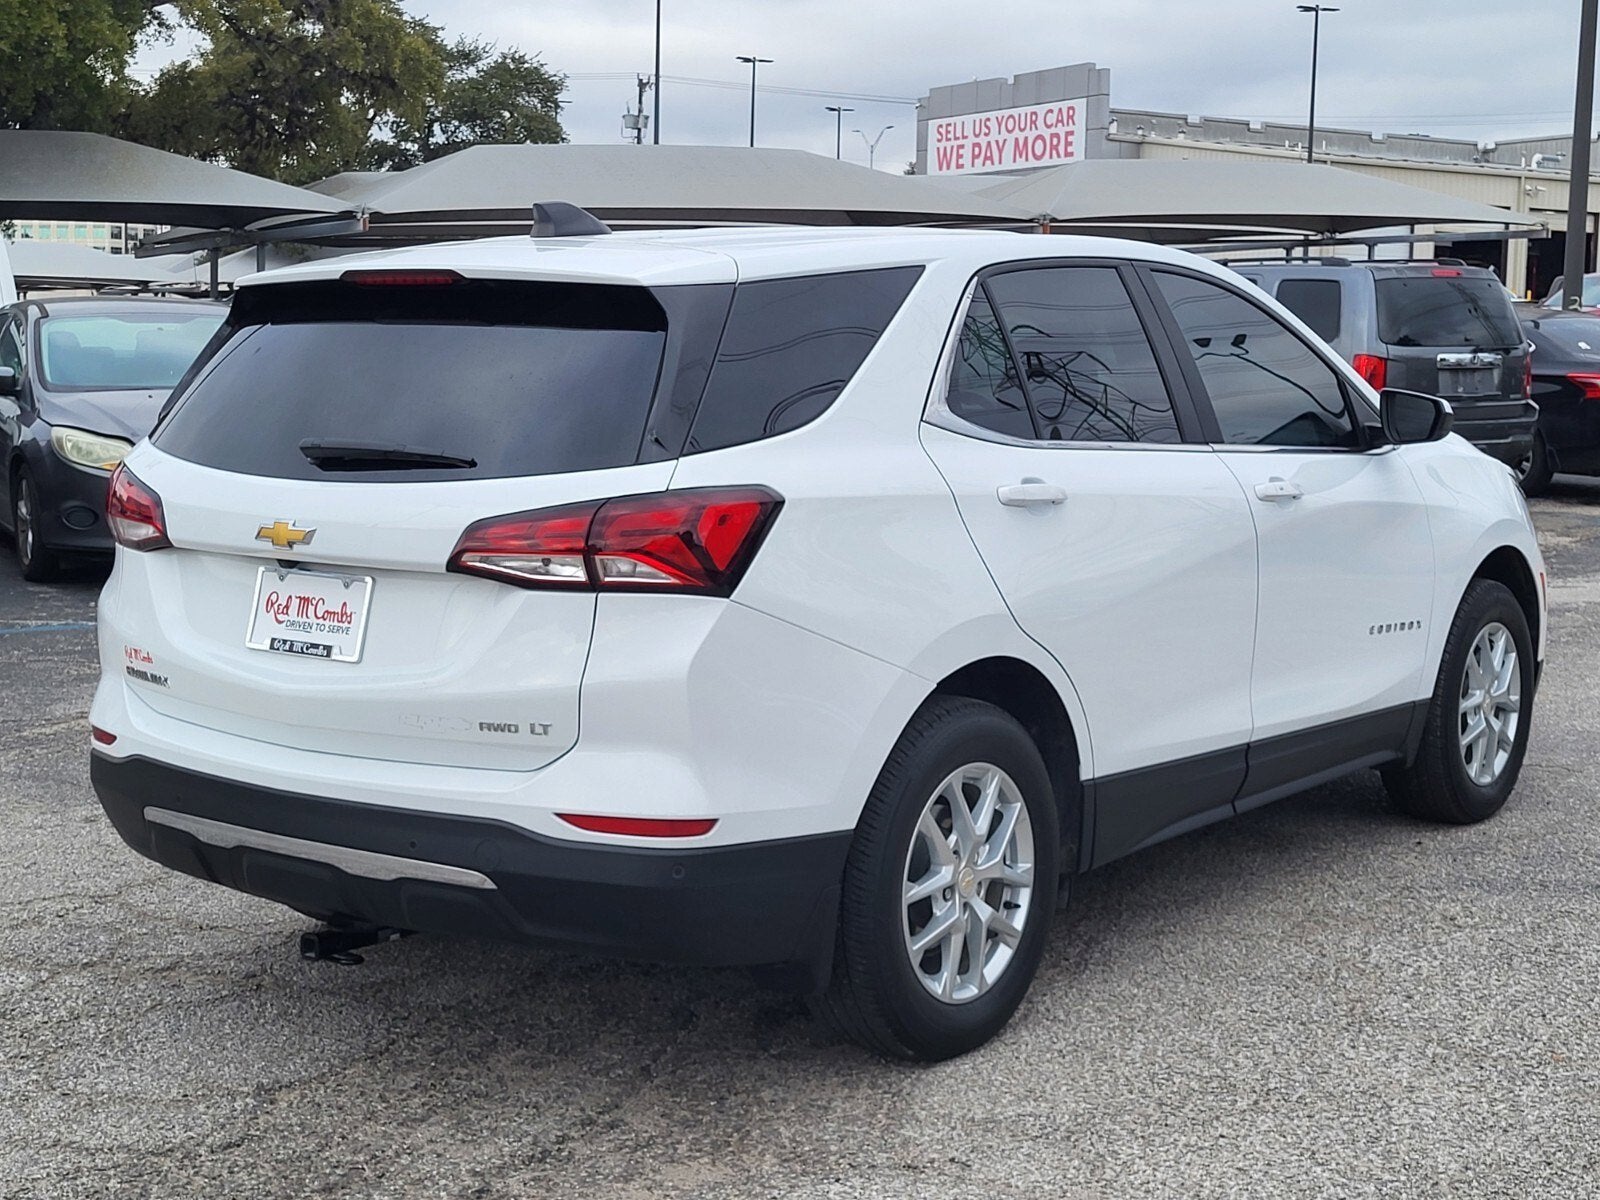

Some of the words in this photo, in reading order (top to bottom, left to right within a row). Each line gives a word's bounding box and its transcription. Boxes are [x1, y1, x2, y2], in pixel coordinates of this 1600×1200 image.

[936, 121, 968, 143] SELL
[972, 118, 991, 138] US
[996, 113, 1038, 135] YOUR
[1043, 105, 1076, 130] CAR
[936, 145, 965, 171] WE
[971, 139, 1008, 167] PAY
[1013, 130, 1075, 163] MORE
[265, 591, 293, 624] Red
[295, 595, 353, 625] McCombs
[285, 619, 313, 631] DRIVEN
[315, 623, 326, 633] TO
[327, 624, 351, 636] SERVE
[478, 721, 519, 734] AWD
[529, 722, 553, 736] LT
